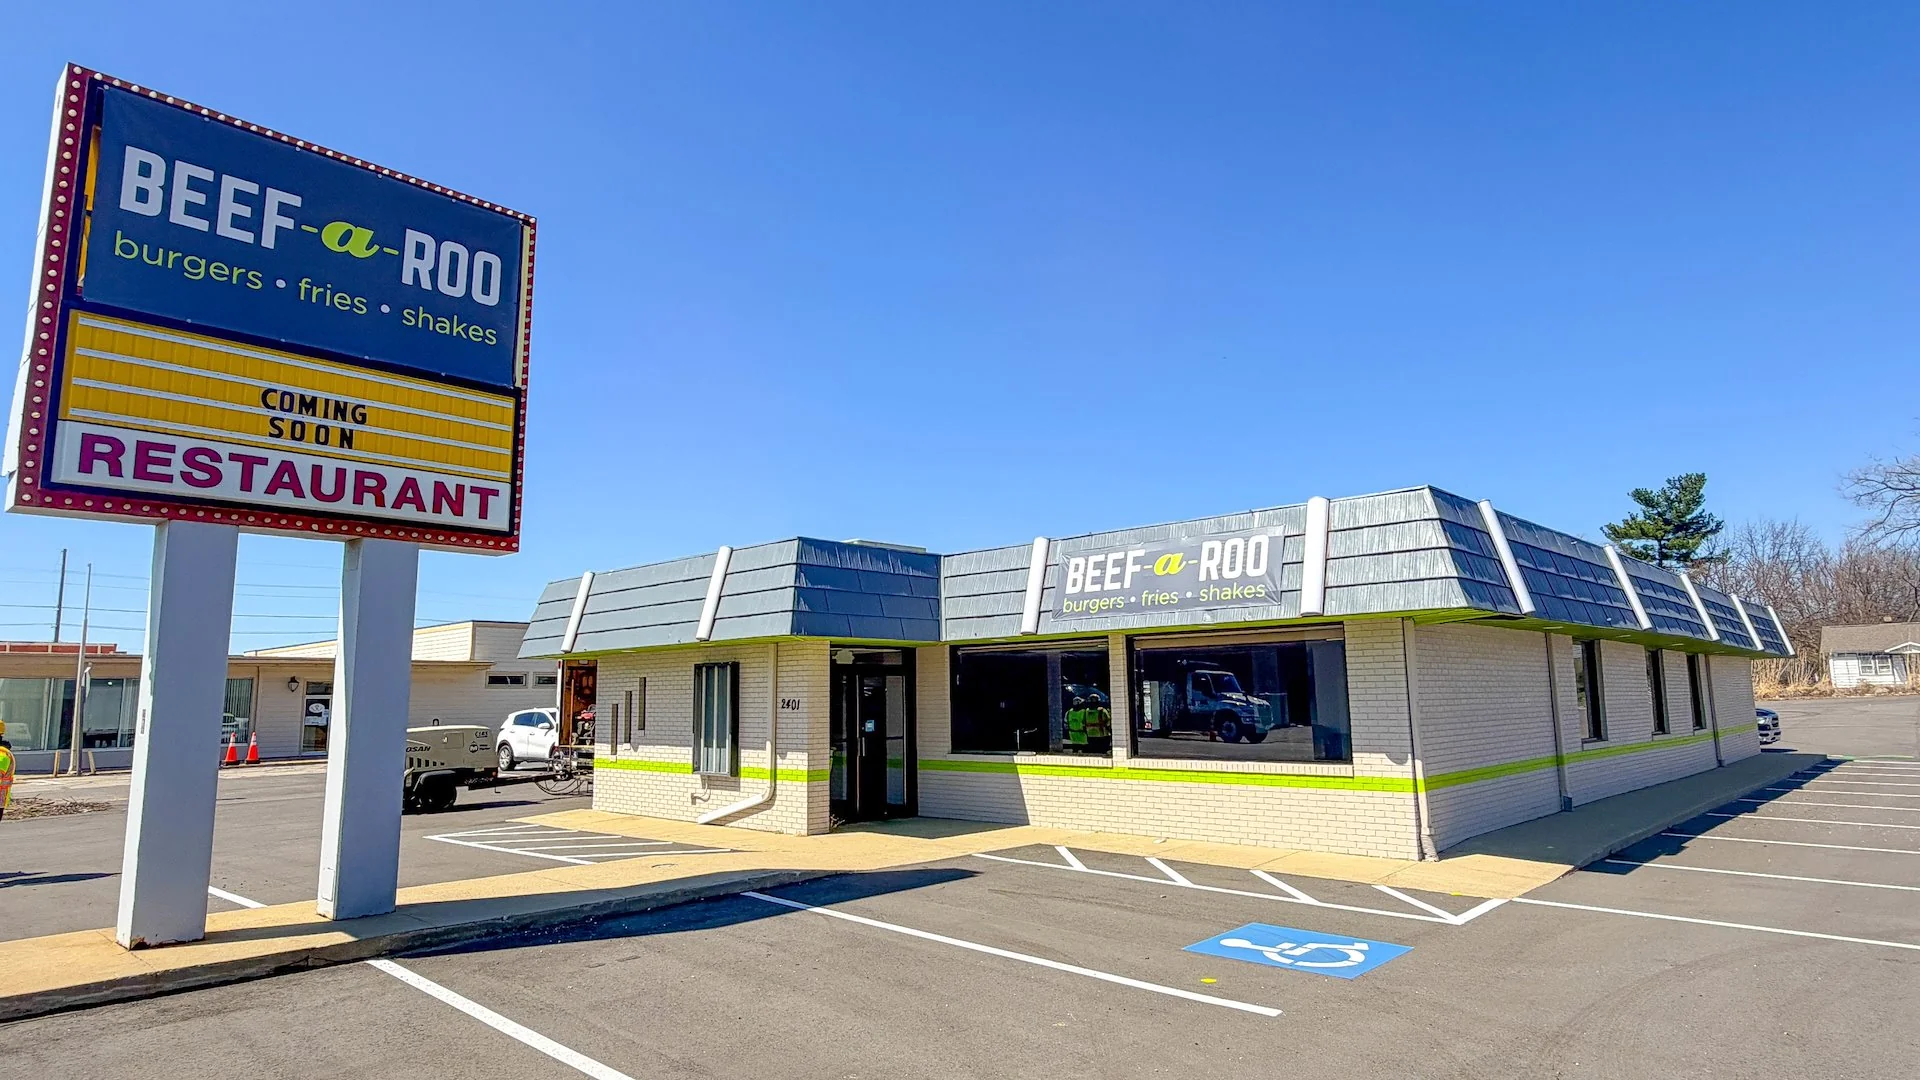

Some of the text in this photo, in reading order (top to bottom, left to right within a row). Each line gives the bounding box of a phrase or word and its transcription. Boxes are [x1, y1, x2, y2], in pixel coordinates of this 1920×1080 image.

[119, 144, 503, 307] BEEF-a-ROO
[113, 230, 498, 346] burgers fries shakes
[261, 388, 367, 425] COMING
[268, 416, 354, 449] SOON
[77, 432, 500, 520] RESTAURANT
[1065, 534, 1270, 595] BEEF-a-ROO
[1062, 581, 1266, 614] burgers fries shakes
[781, 698, 801, 711] 2401
